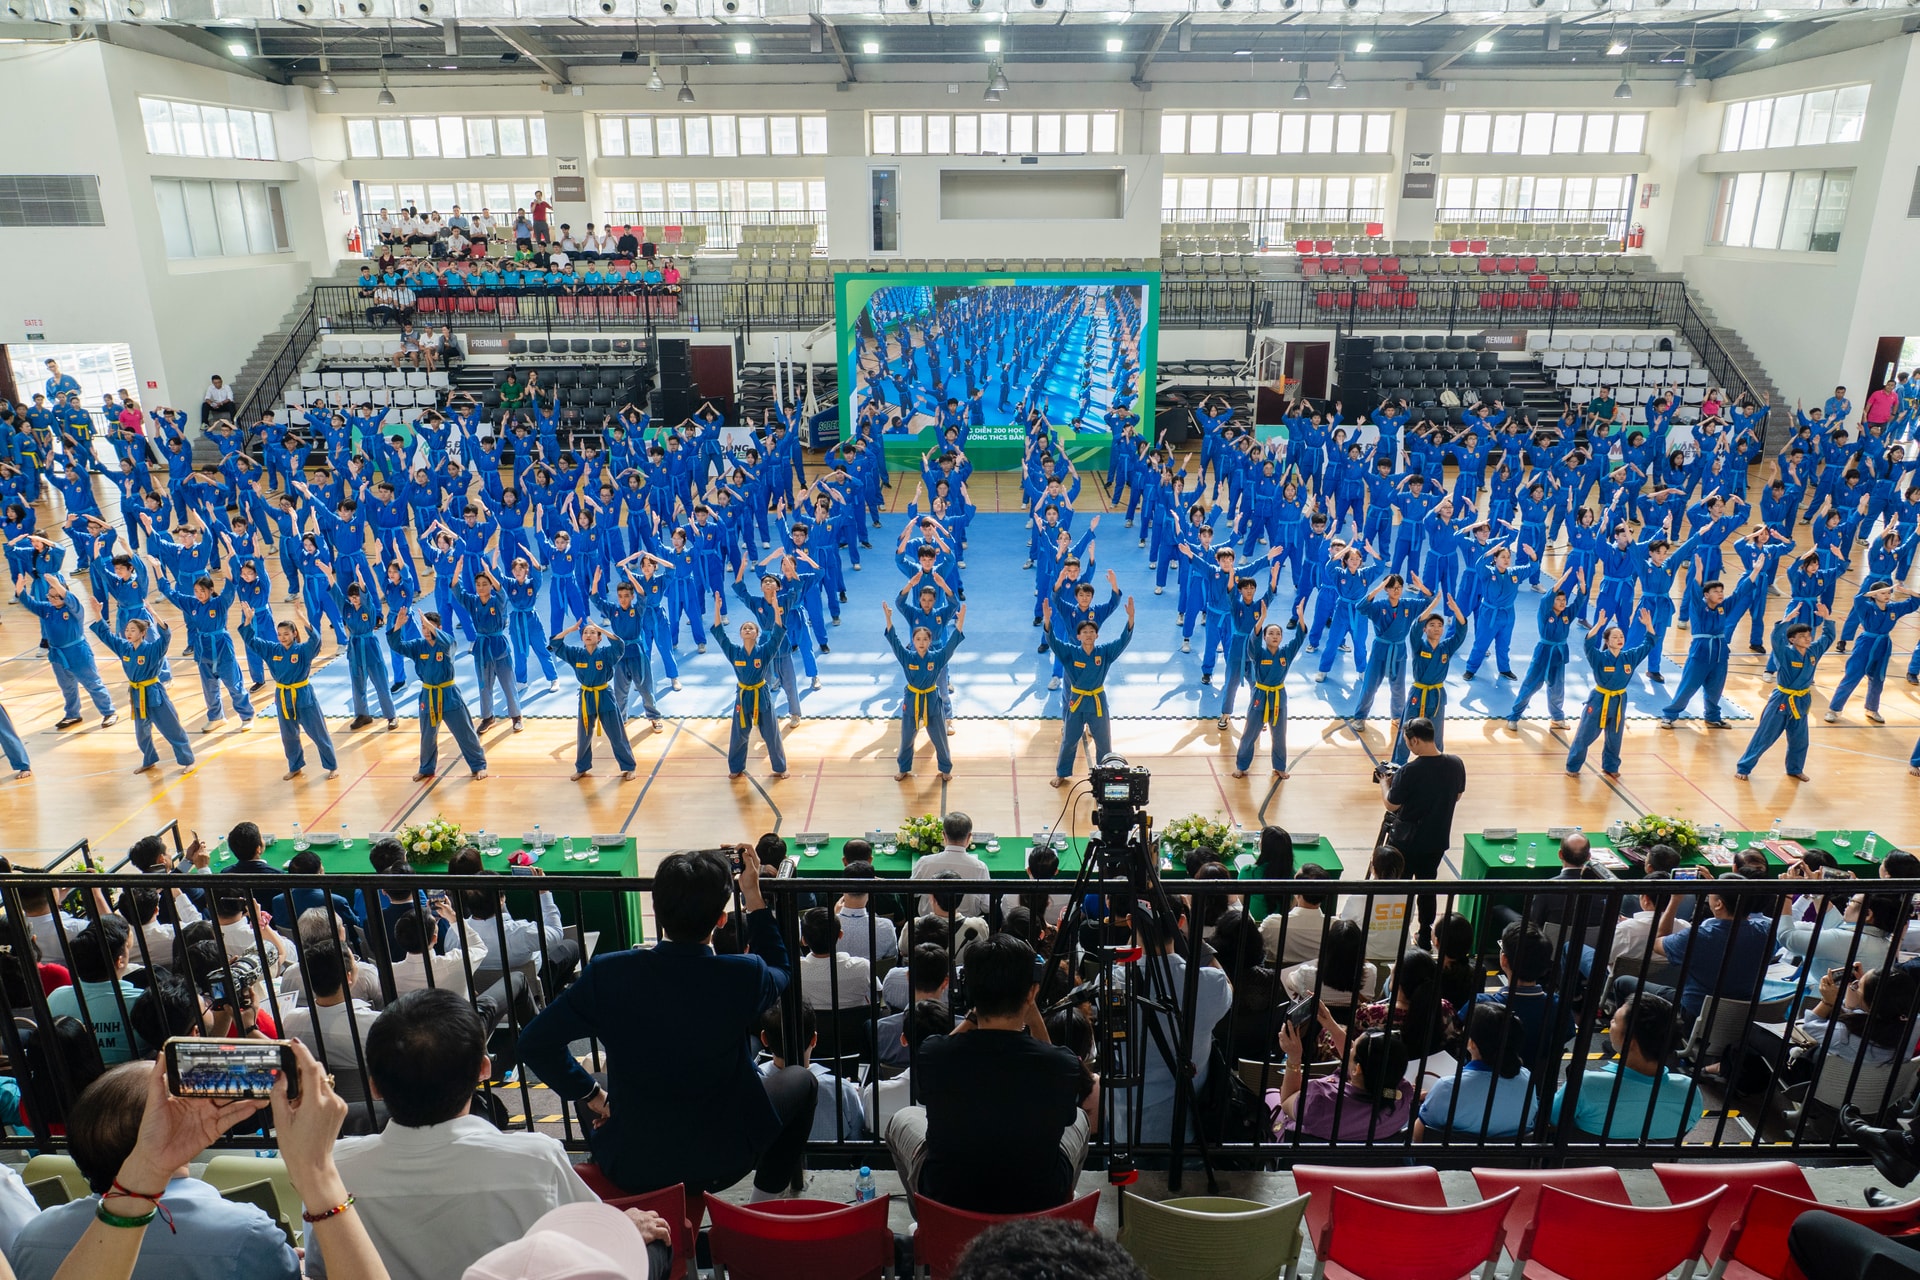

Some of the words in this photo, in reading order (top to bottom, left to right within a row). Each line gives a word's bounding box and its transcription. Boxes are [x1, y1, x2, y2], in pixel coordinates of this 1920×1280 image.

[471, 339, 502, 348] PREMIUM
[1485, 335, 1513, 344] REMIUM
[966, 432, 987, 440] ƯỜNG
[98, 1037, 116, 1049] AM
